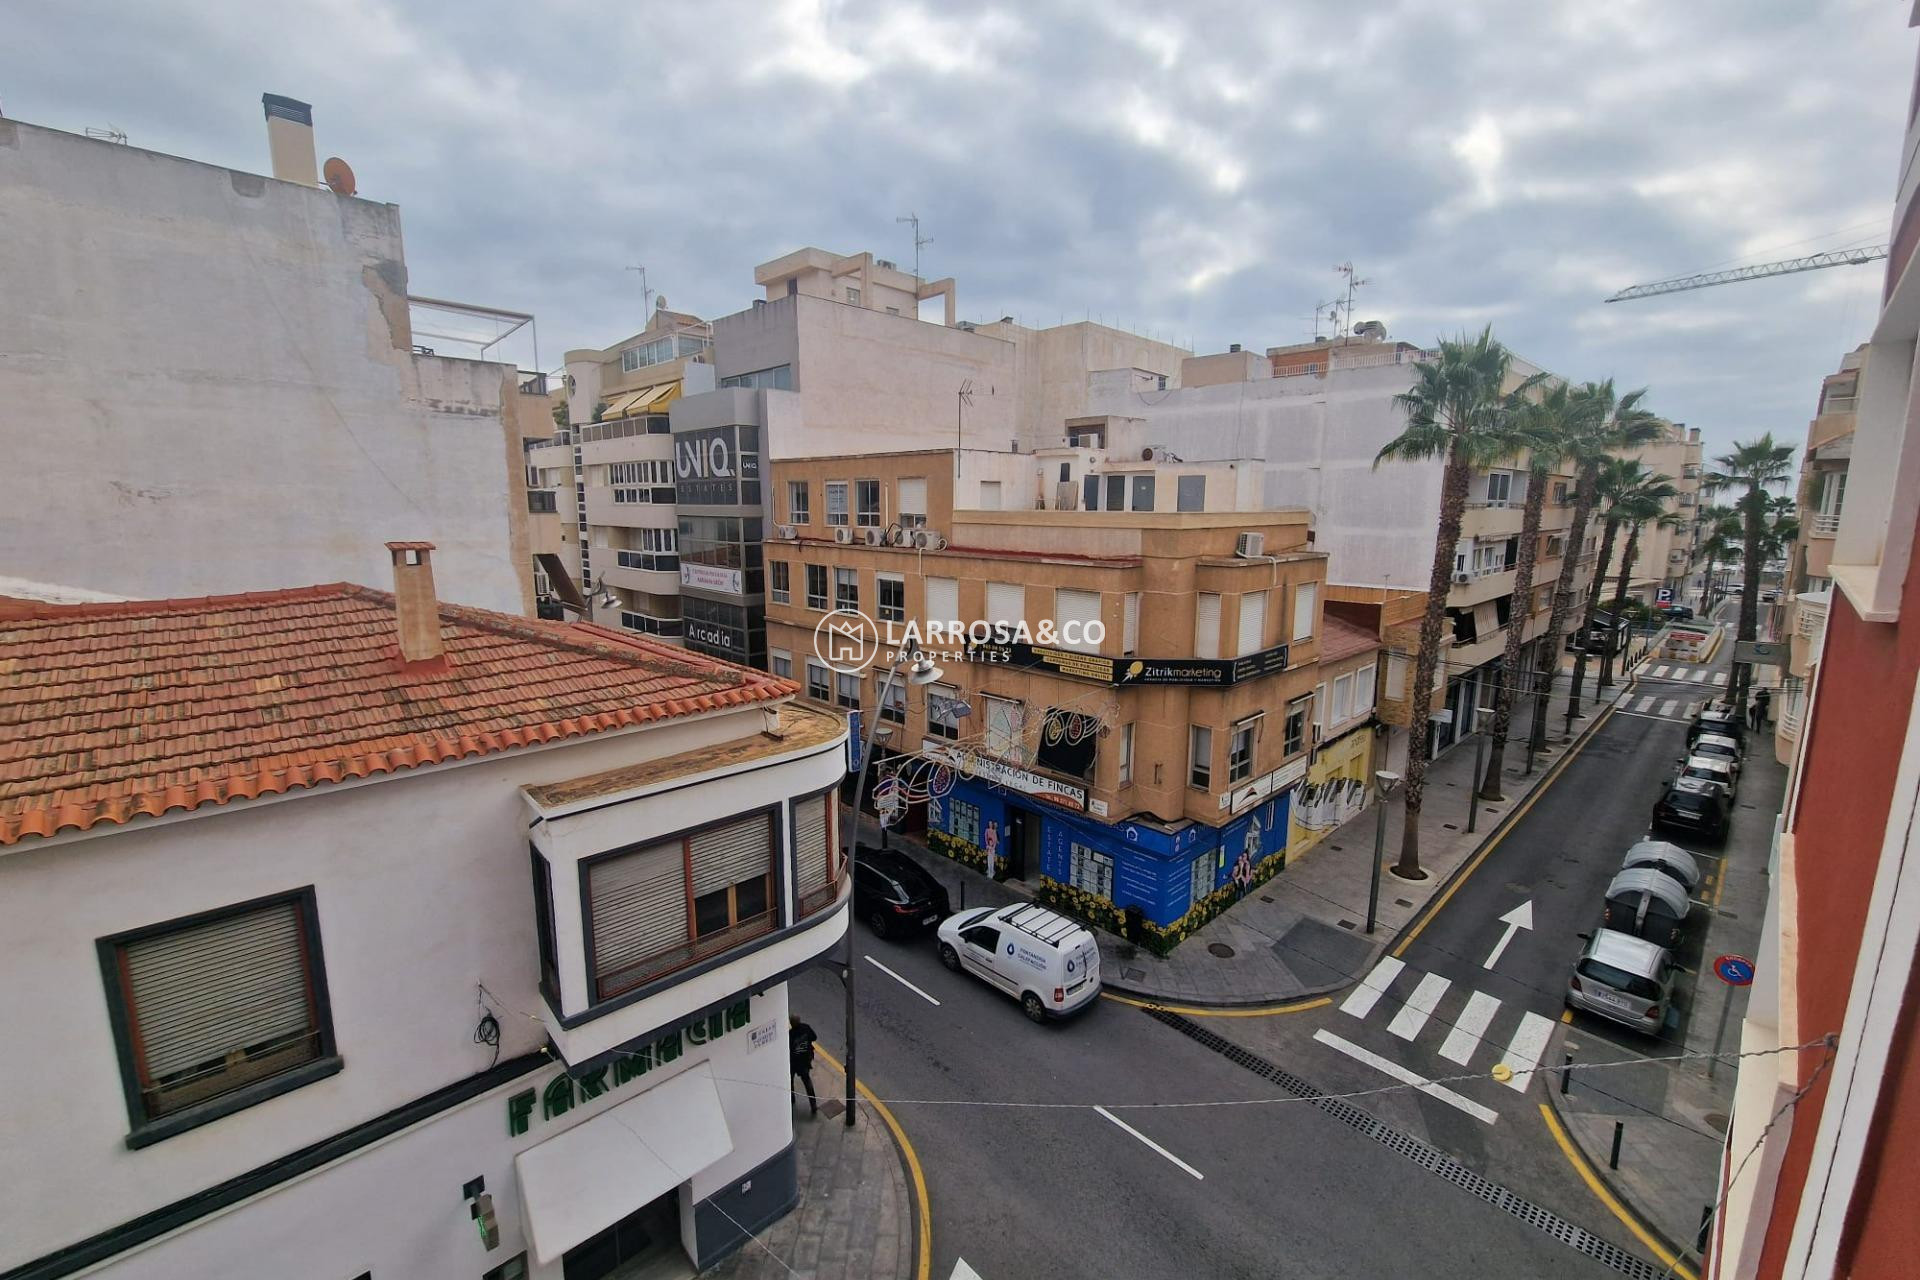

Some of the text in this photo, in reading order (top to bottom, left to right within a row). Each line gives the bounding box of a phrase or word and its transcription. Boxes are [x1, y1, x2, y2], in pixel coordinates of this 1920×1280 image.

[689, 623, 730, 646] Arcadia
[1145, 667, 1221, 678] Zitrikmarketing
[956, 752, 1028, 781] ANISTRACIÓN
[1032, 775, 1044, 787] DE
[1047, 780, 1083, 799] FINCAS
[508, 999, 751, 1138] FARMACIA
